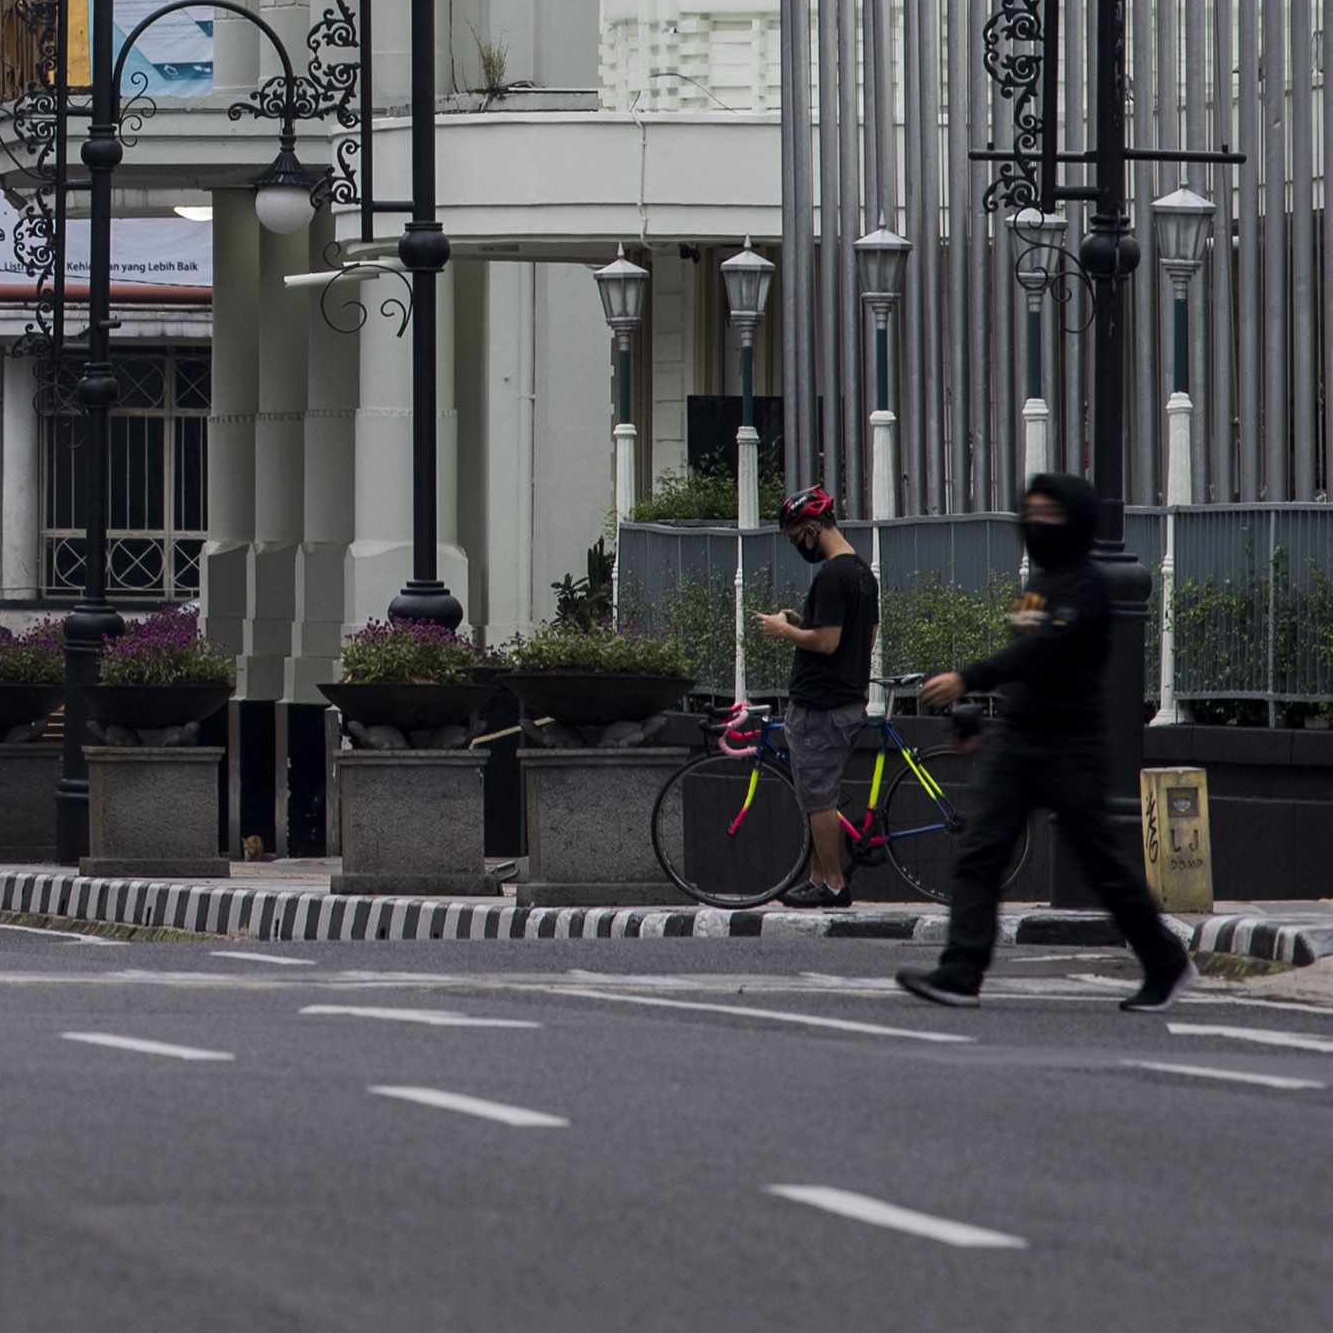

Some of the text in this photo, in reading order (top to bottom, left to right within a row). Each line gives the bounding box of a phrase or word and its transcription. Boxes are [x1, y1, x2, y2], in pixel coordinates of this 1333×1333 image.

[121, 263, 146, 275] yang
[147, 261, 176, 272] Lebih
[176, 261, 199, 272] Baik
